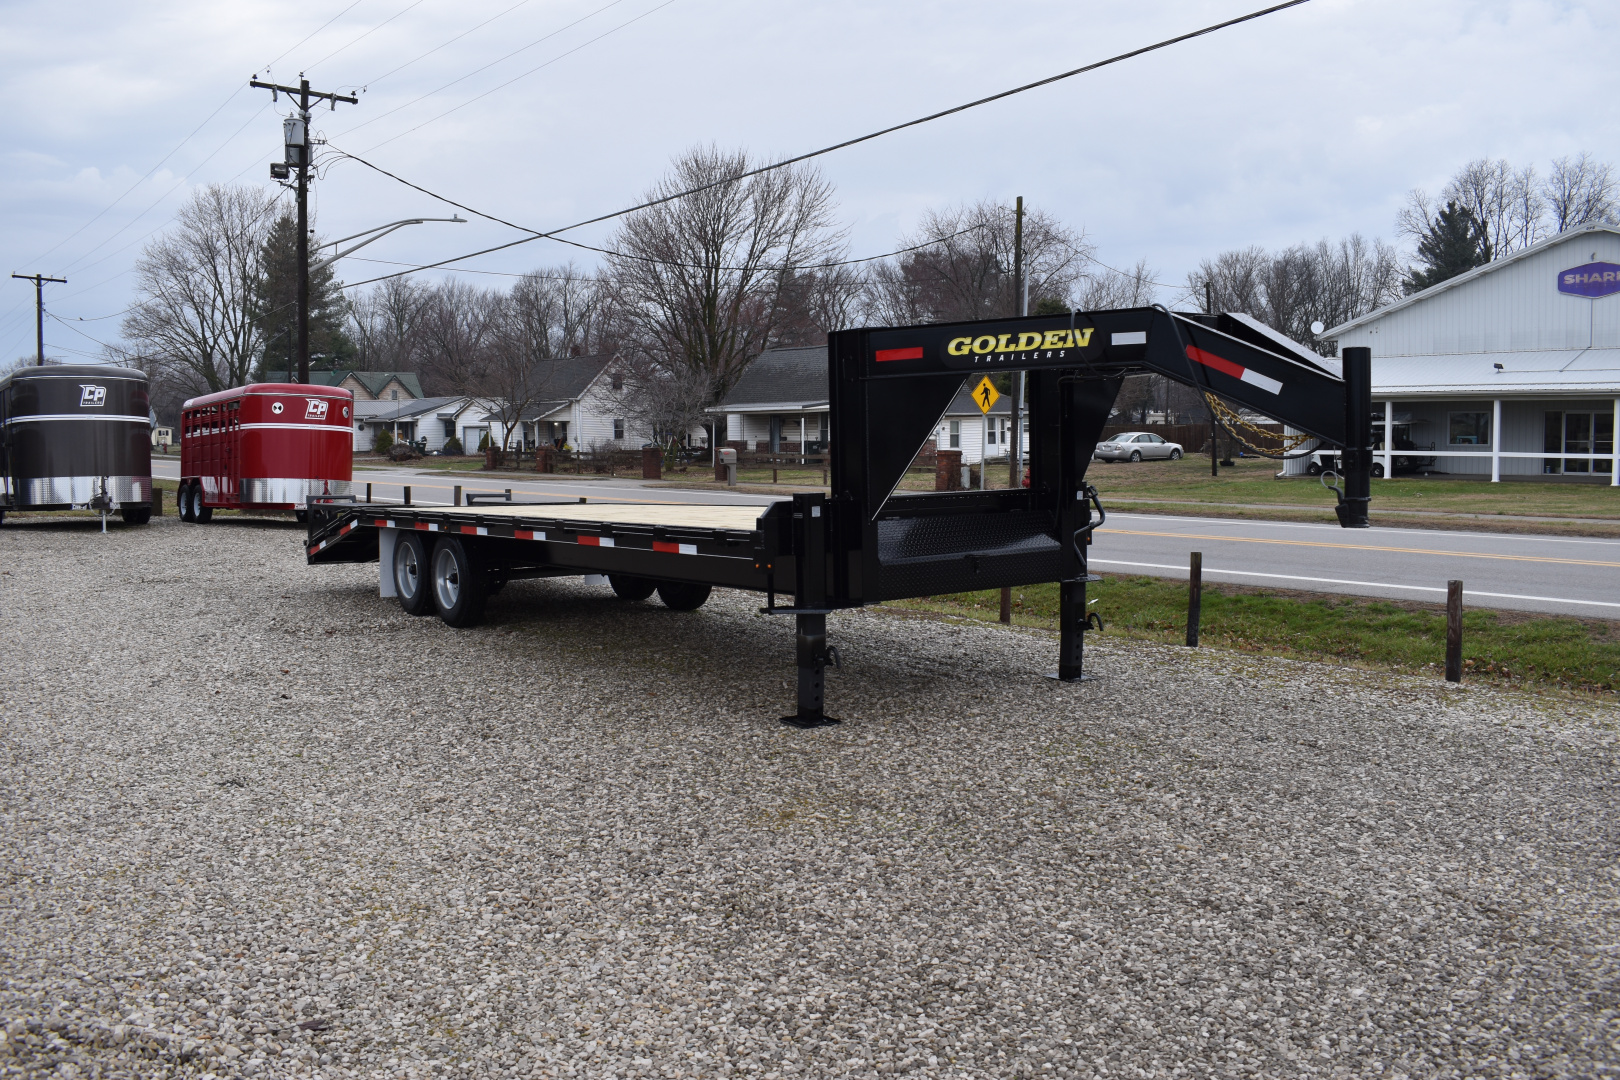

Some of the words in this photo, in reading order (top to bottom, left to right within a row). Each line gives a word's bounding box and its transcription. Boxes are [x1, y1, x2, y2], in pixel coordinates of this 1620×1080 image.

[947, 328, 1095, 356] GOLDEN
[974, 351, 1066, 363] TRAILERS
[84, 386, 105, 401] CP
[309, 400, 327, 414] CP
